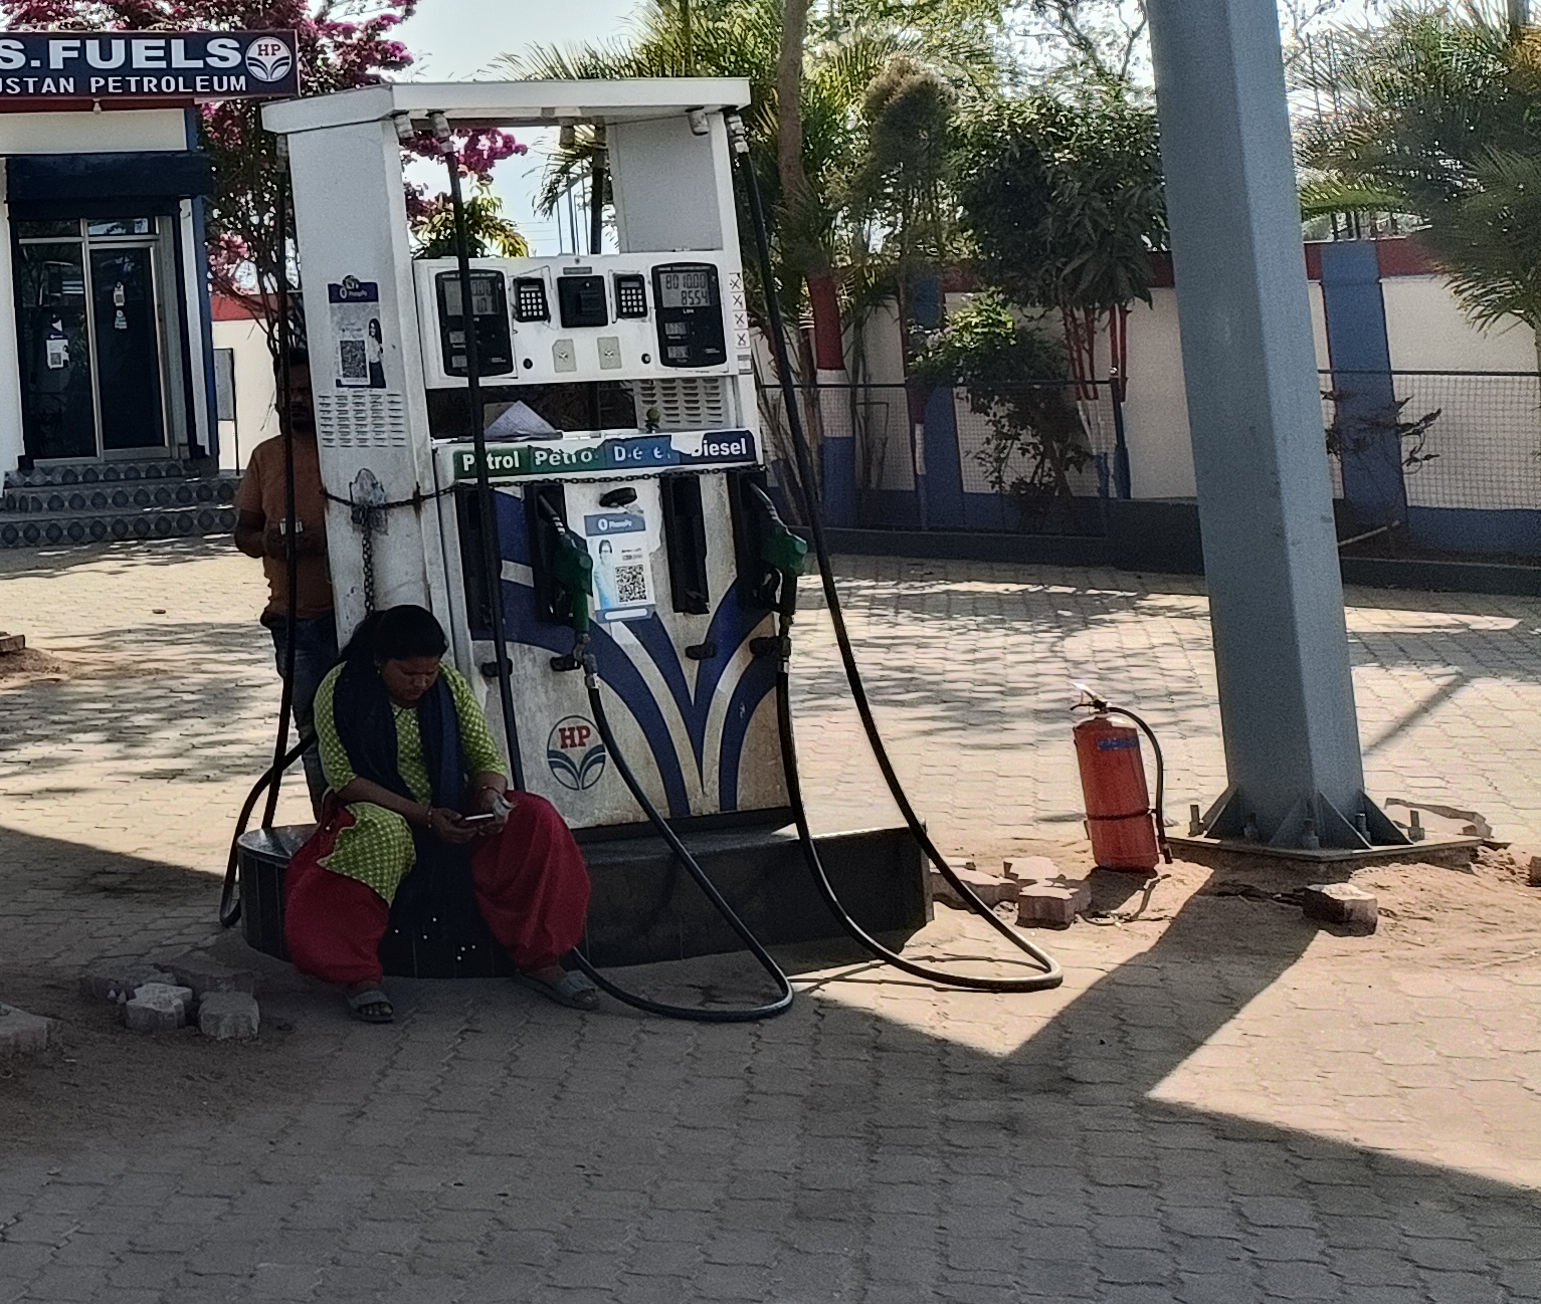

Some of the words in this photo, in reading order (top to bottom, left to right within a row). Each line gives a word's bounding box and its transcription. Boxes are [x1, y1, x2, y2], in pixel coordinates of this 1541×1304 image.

[257, 42, 282, 57] HP
[90, 74, 247, 93] PETROLEUM
[462, 450, 520, 471] Ptrol
[558, 725, 591, 749] HP
